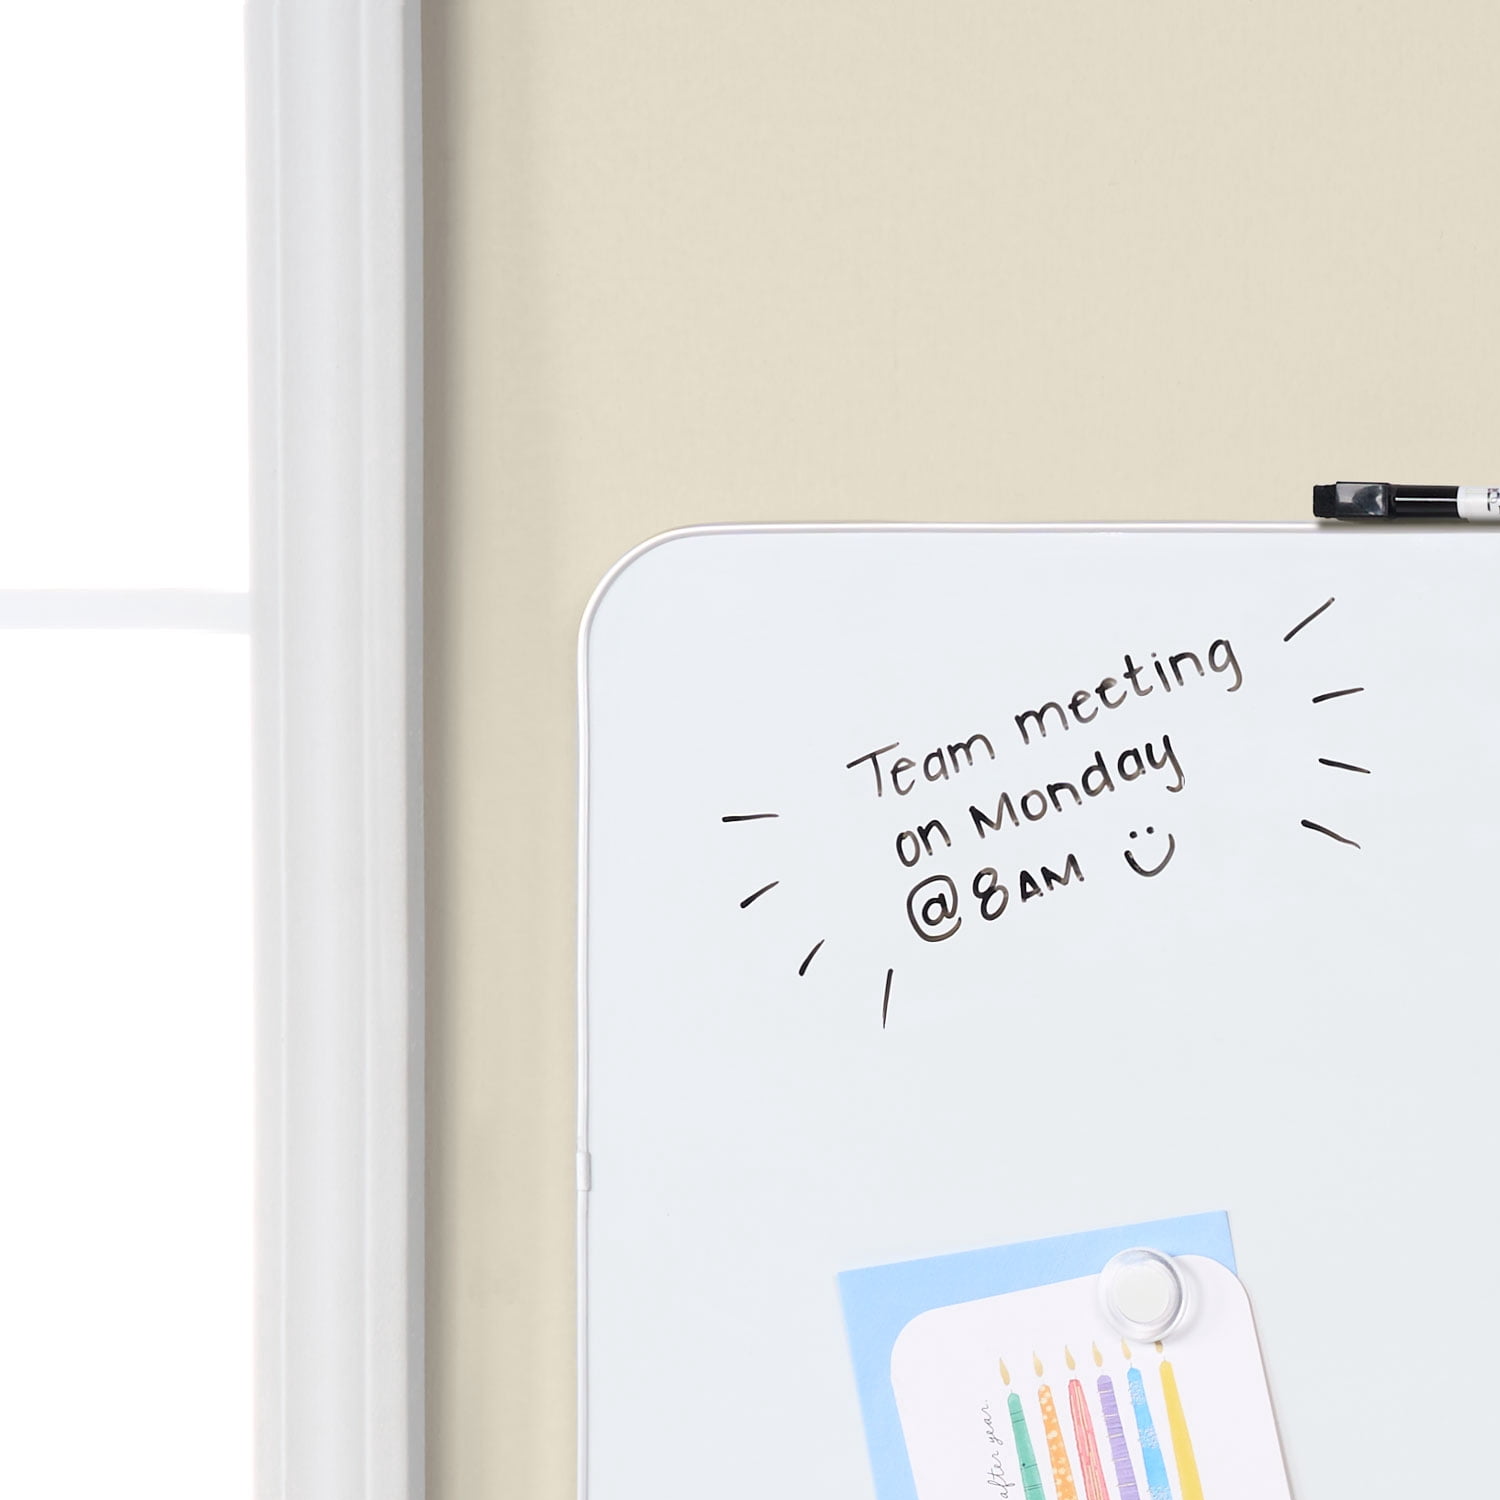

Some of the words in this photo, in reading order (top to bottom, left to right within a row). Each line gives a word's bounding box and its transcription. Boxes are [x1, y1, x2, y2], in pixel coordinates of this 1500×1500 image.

[847, 734, 994, 796] Team
[1015, 640, 1242, 744] meeting
[896, 820, 952, 867] on
[969, 735, 1185, 838] Monday
[981, 1400, 1003, 1445] year.
[986, 1450, 1016, 1499] after
